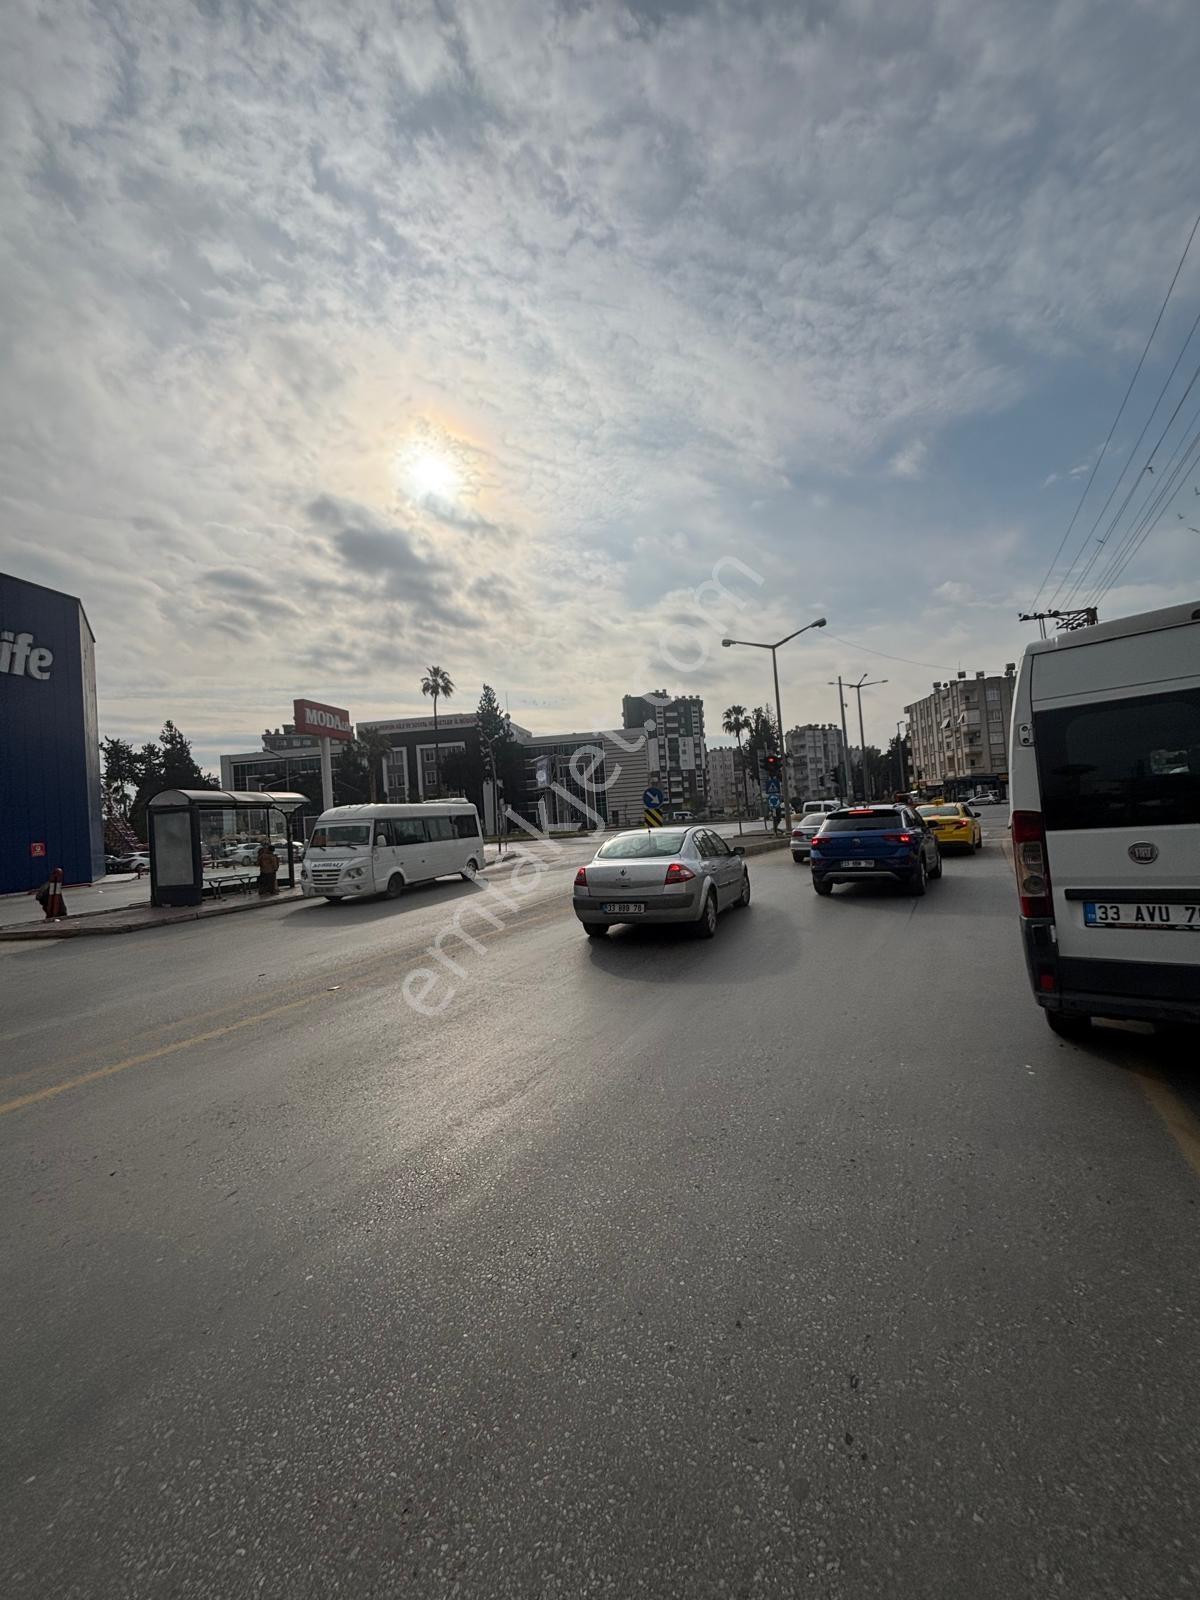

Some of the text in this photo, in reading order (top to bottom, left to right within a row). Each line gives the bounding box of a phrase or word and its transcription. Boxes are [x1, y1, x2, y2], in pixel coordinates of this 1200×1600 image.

[1098, 905, 1200, 923] 33 AVU 7
